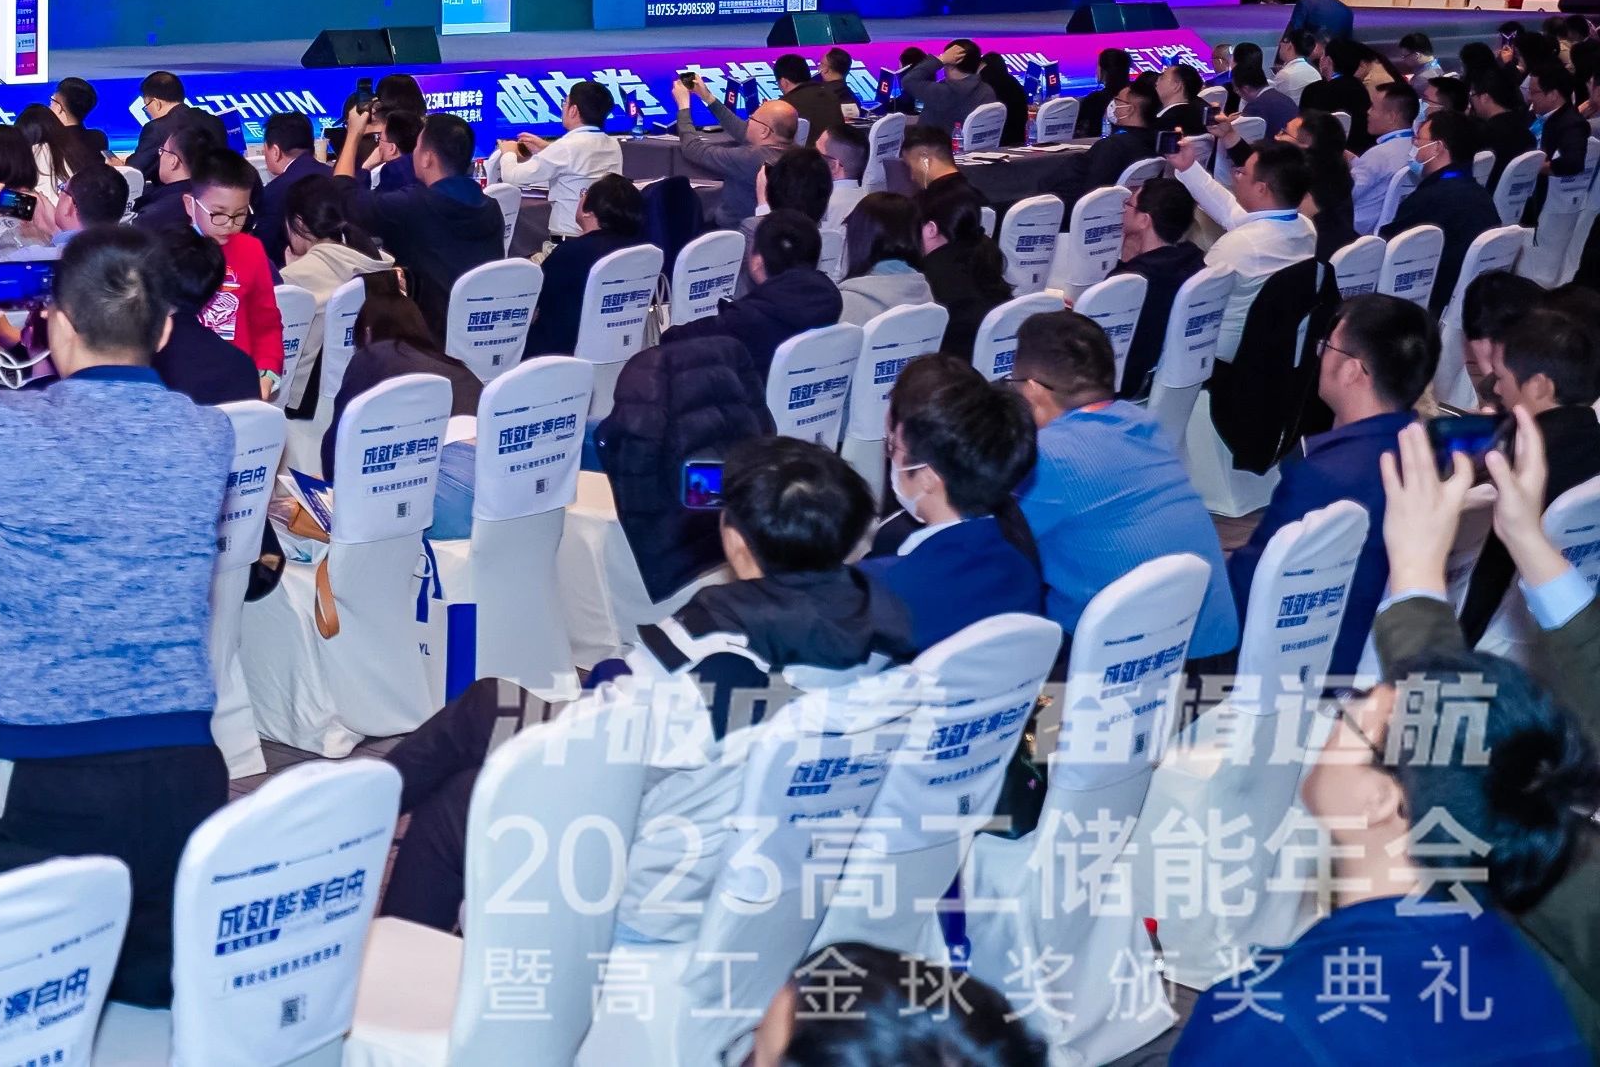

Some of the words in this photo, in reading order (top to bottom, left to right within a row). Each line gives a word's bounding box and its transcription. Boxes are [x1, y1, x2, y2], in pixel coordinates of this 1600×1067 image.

[655, 2, 715, 16] 0755-29985589
[499, 413, 577, 447] 成就能源自由
[363, 436, 439, 466] 成就能源自由
[217, 869, 366, 940] 成就能源自由
